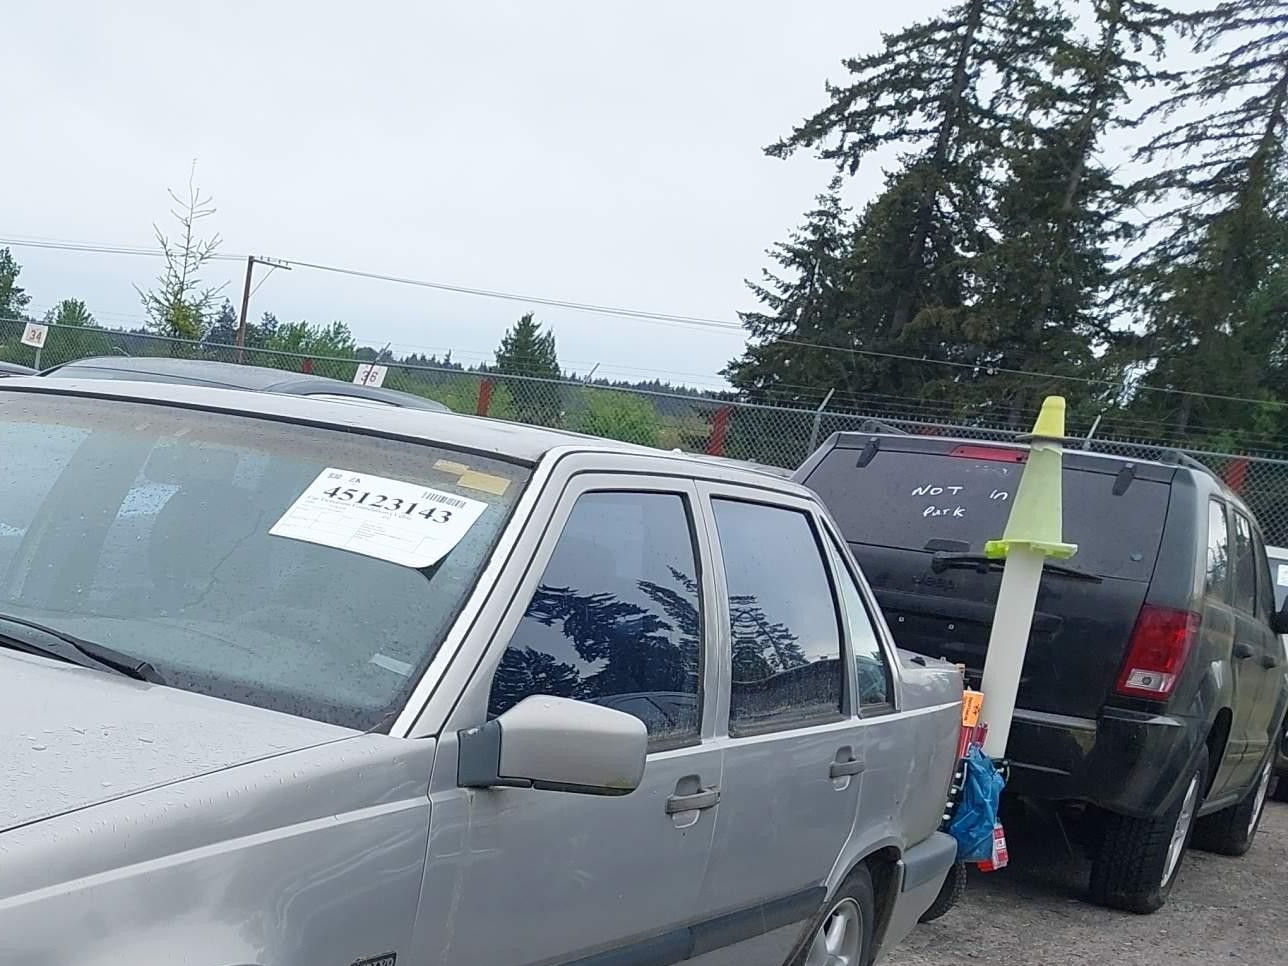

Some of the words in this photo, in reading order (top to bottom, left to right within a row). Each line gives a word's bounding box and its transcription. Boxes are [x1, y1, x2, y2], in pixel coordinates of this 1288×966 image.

[29, 329, 43, 341] 34
[360, 371, 379, 383] 36
[323, 486, 452, 524] 45123143
